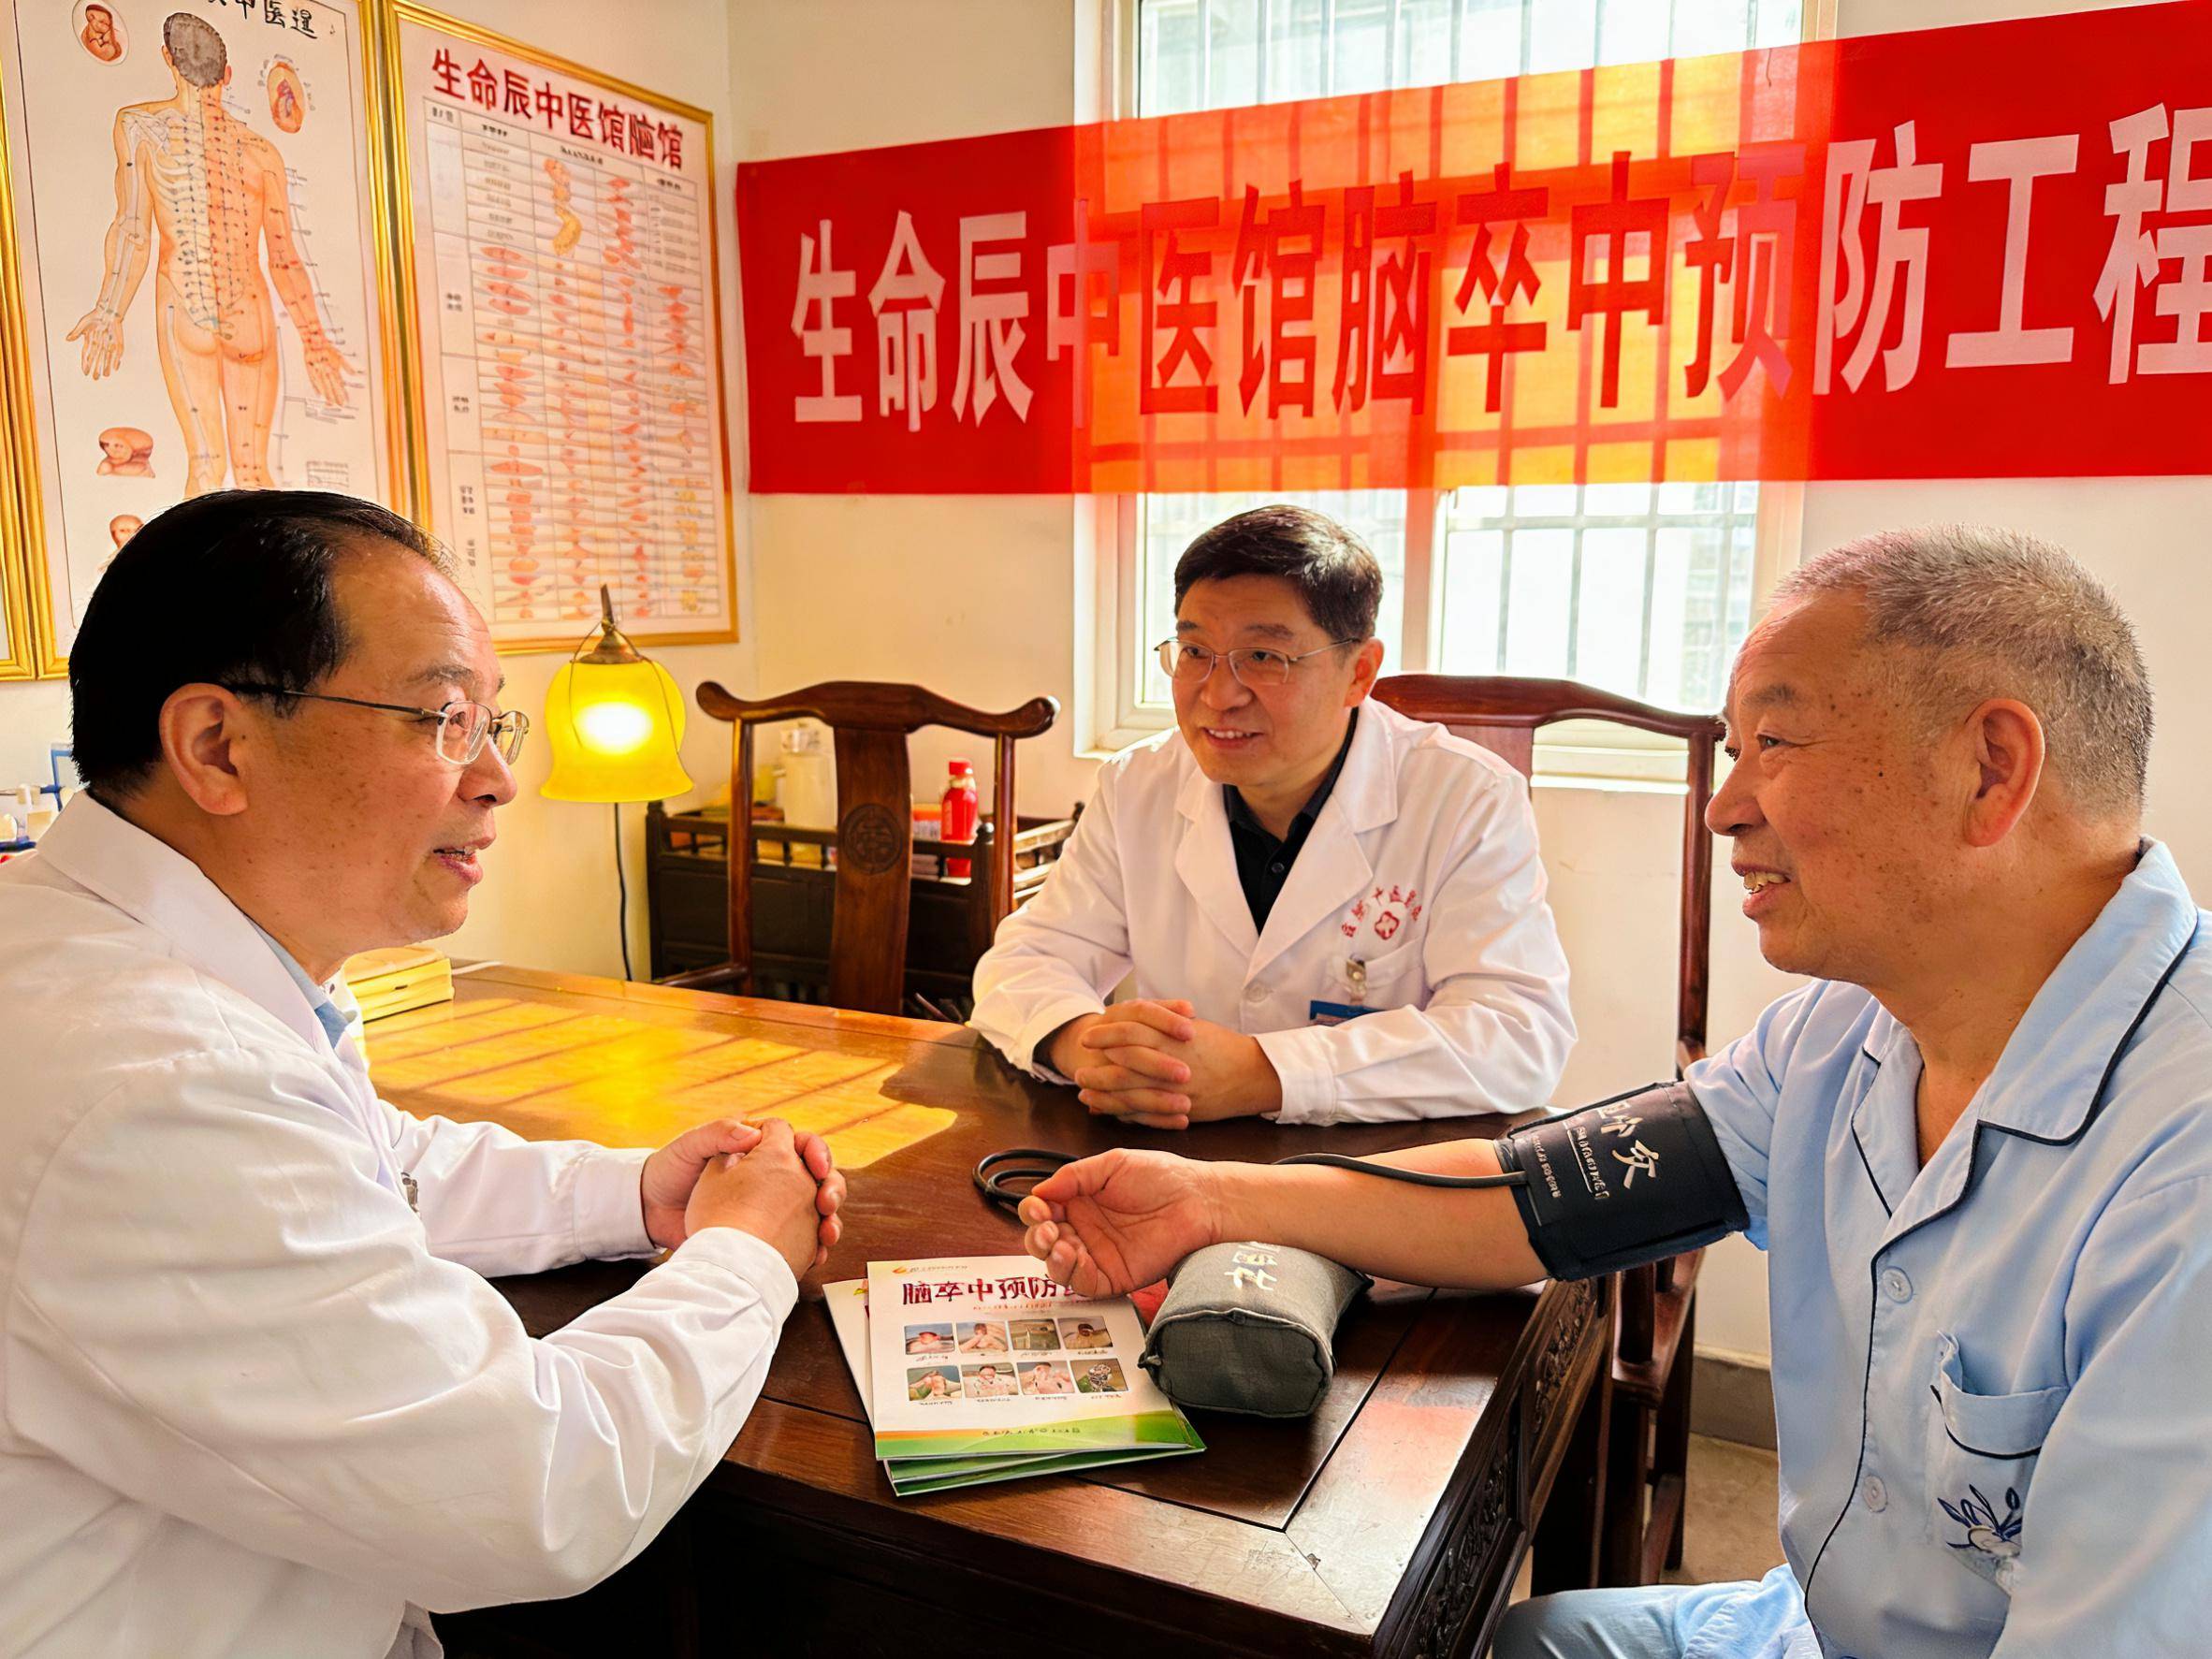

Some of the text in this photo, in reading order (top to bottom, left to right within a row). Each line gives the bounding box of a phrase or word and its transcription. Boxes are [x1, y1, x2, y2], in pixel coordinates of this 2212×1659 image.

[431, 48, 685, 170] 生命辰中医馆脑馆
[791, 102, 2212, 432] 生命辰中医馆脑卒中预防工程
[902, 1273, 1073, 1305] 脑卒中预防
